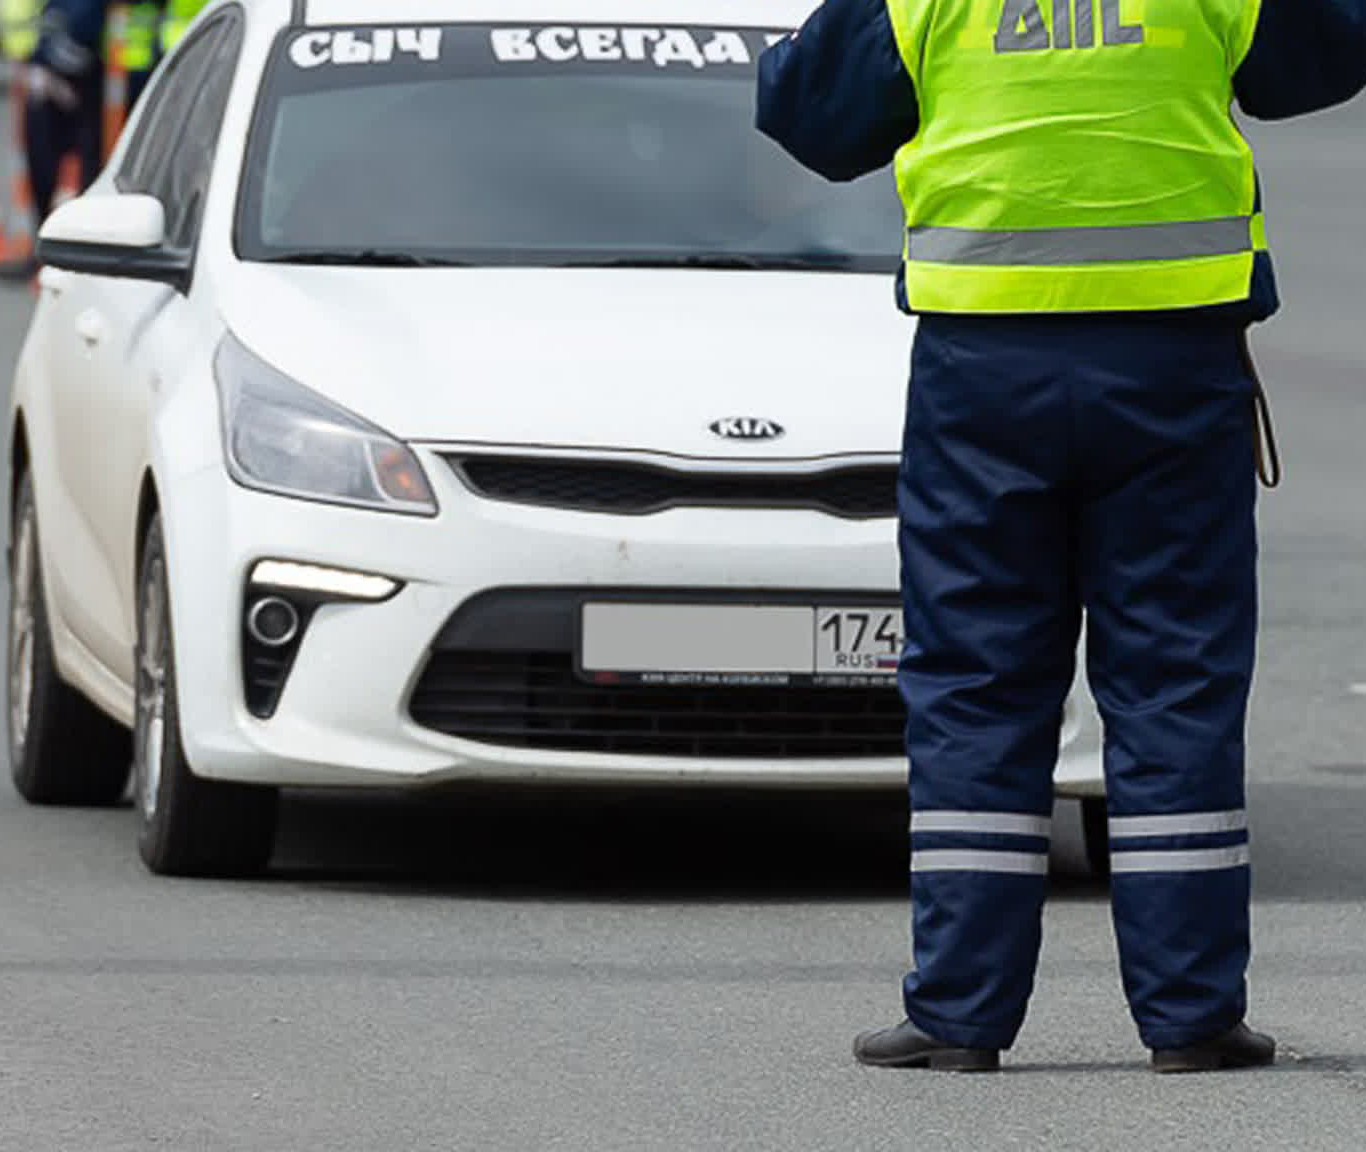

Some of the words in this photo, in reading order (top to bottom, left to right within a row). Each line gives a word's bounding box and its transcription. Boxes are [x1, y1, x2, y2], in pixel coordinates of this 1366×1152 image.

[289, 27, 442, 68] СЫЧ
[490, 26, 751, 68] ВСЕГДА
[714, 418, 779, 438] KIA
[821, 613, 901, 653] 174
[835, 654, 874, 668] RUS
